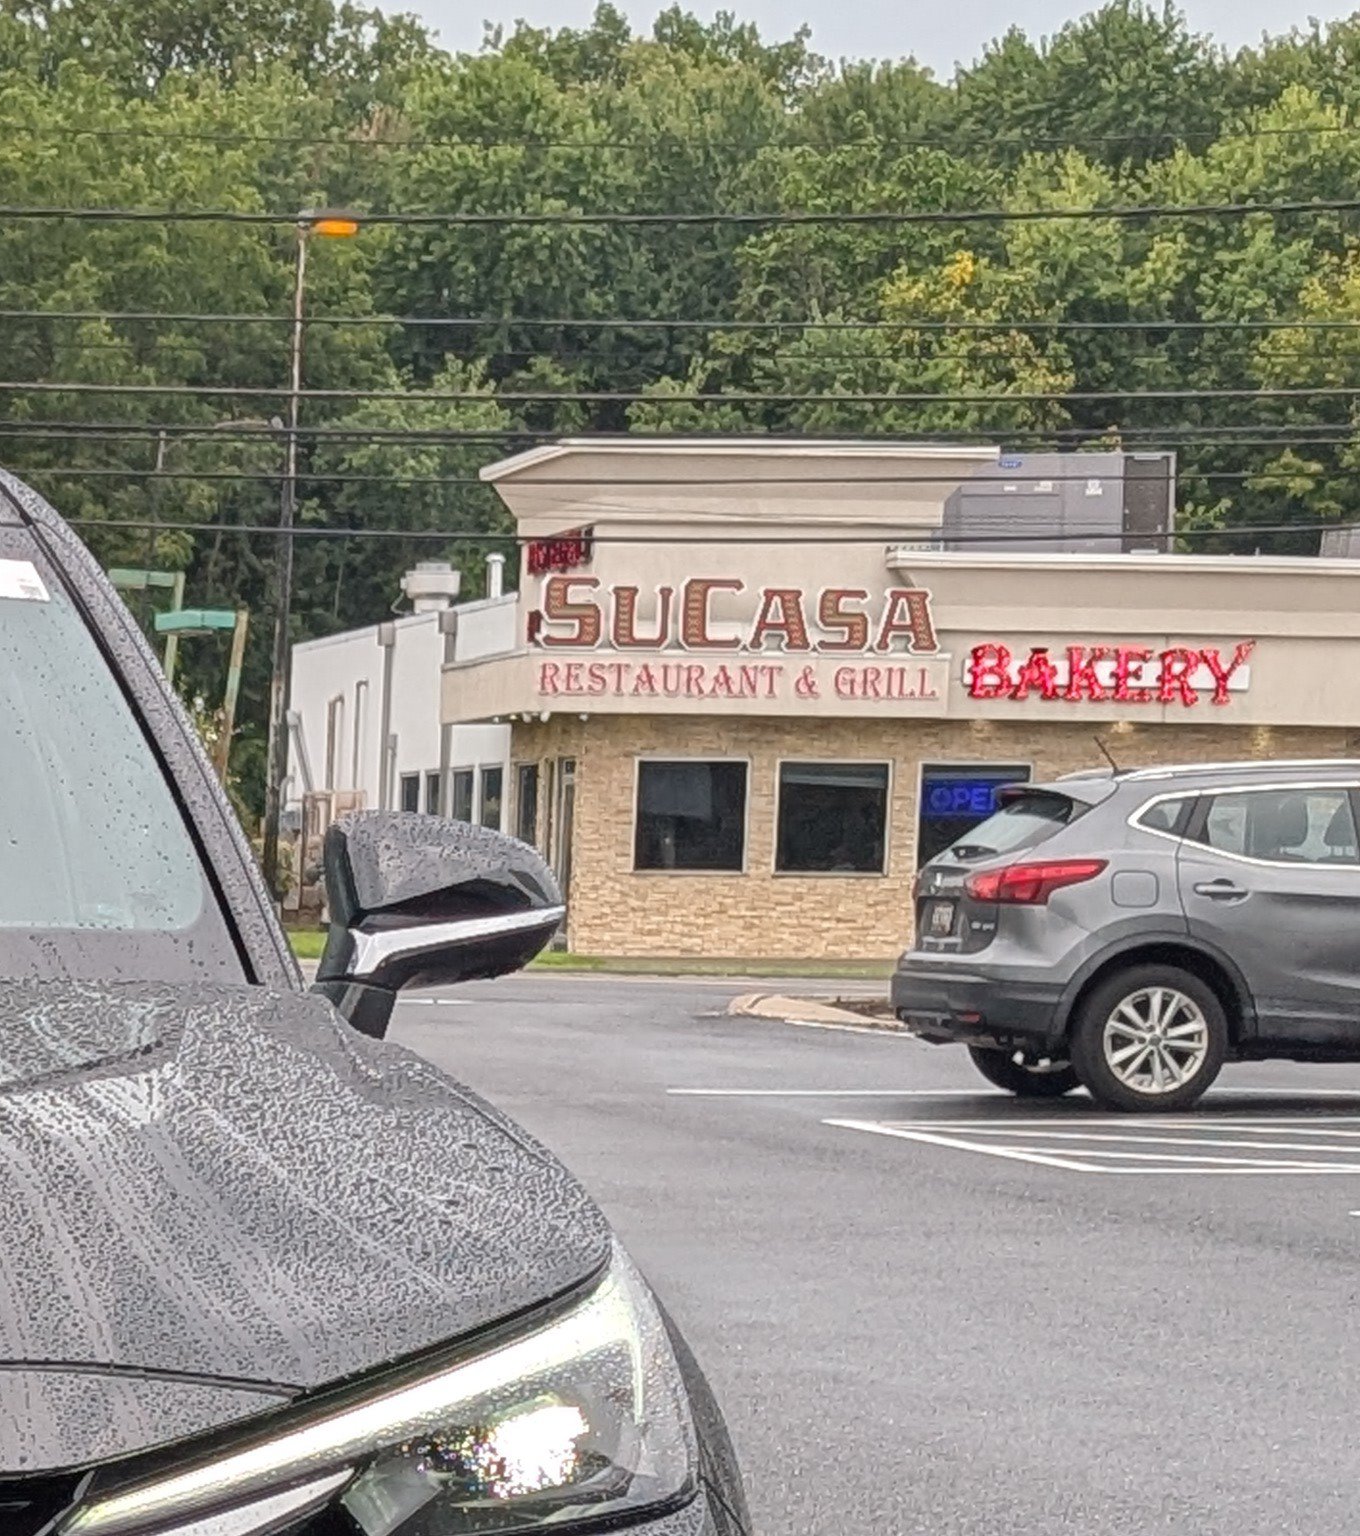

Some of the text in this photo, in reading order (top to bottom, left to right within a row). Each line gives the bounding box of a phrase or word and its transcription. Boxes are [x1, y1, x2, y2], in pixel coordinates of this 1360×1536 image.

[539, 662, 939, 699] RESTAURANT & GRILL
[968, 640, 1256, 706] BAKERY
